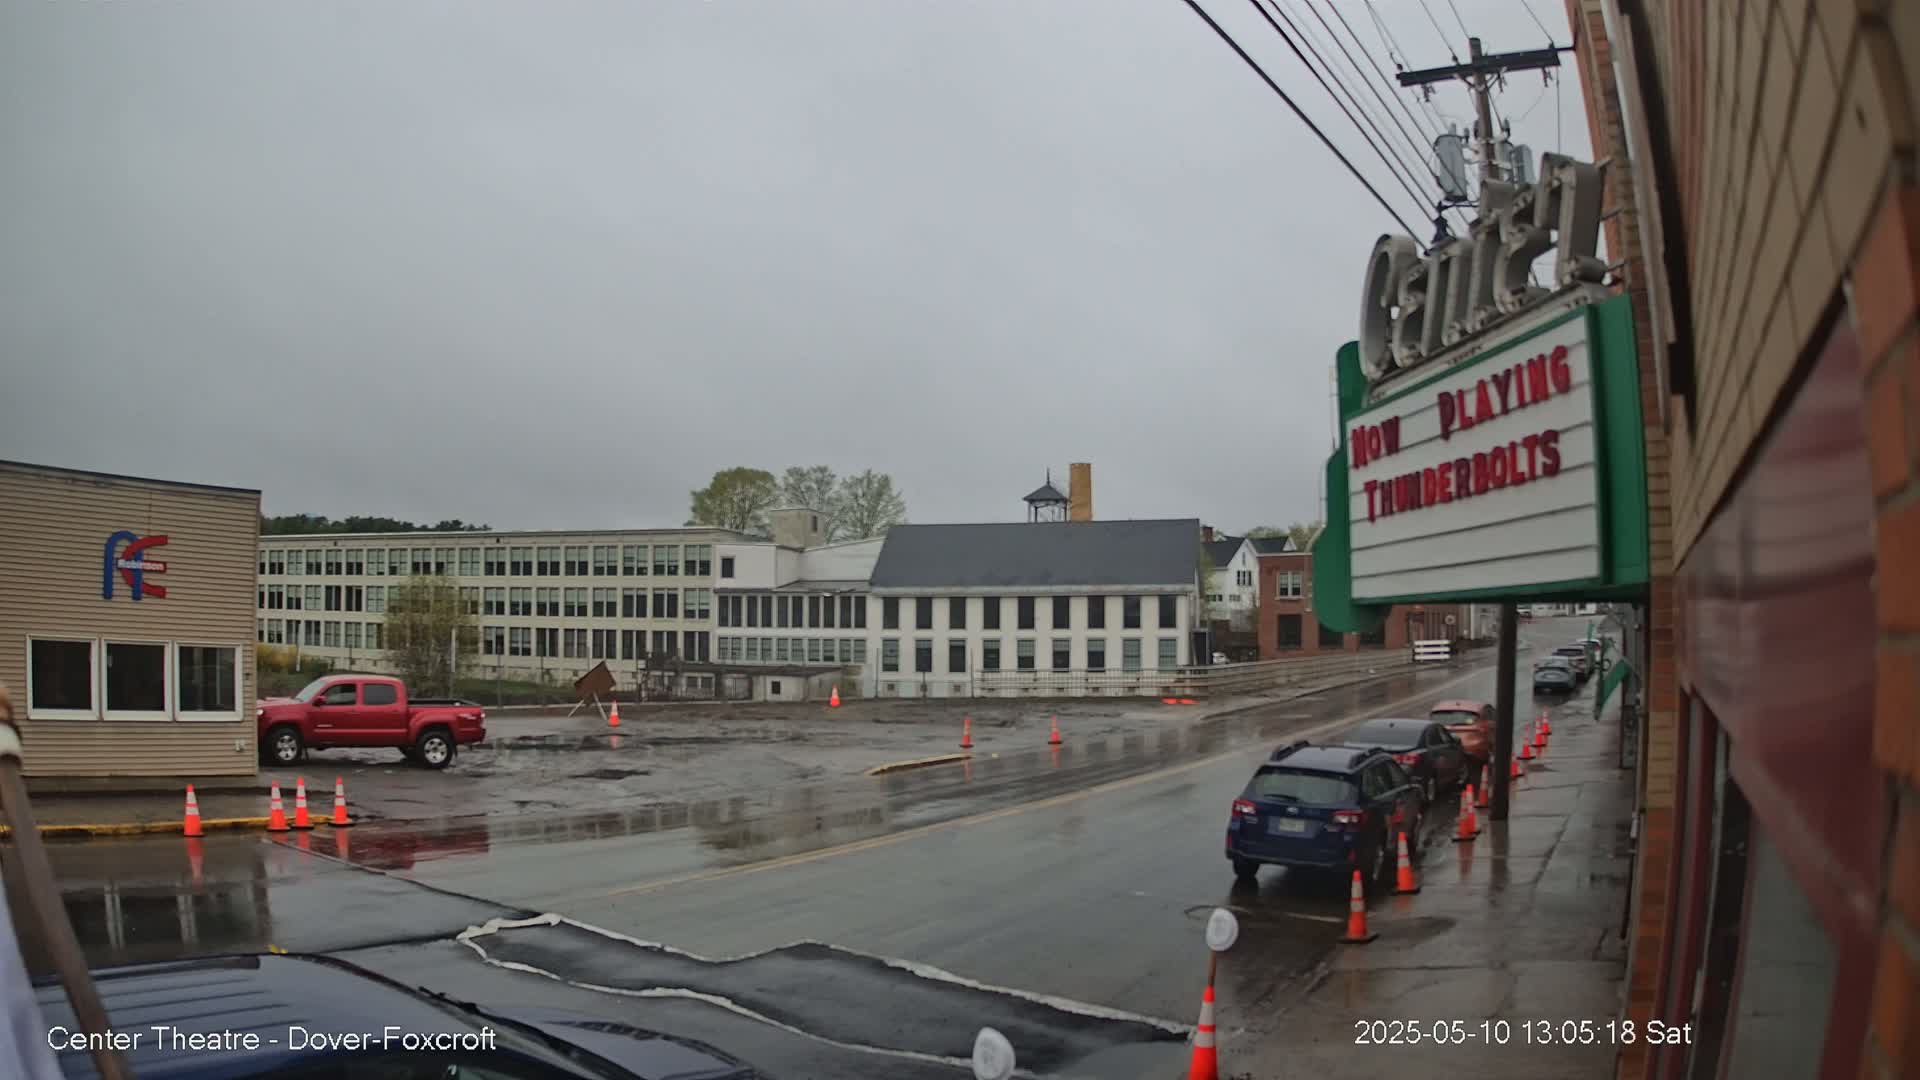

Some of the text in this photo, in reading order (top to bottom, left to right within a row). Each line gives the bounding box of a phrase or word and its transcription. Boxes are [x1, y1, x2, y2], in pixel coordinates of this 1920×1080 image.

[1352, 345, 1572, 469] NOW PLAYING
[1364, 430, 1562, 522] THUNDERBOLTS
